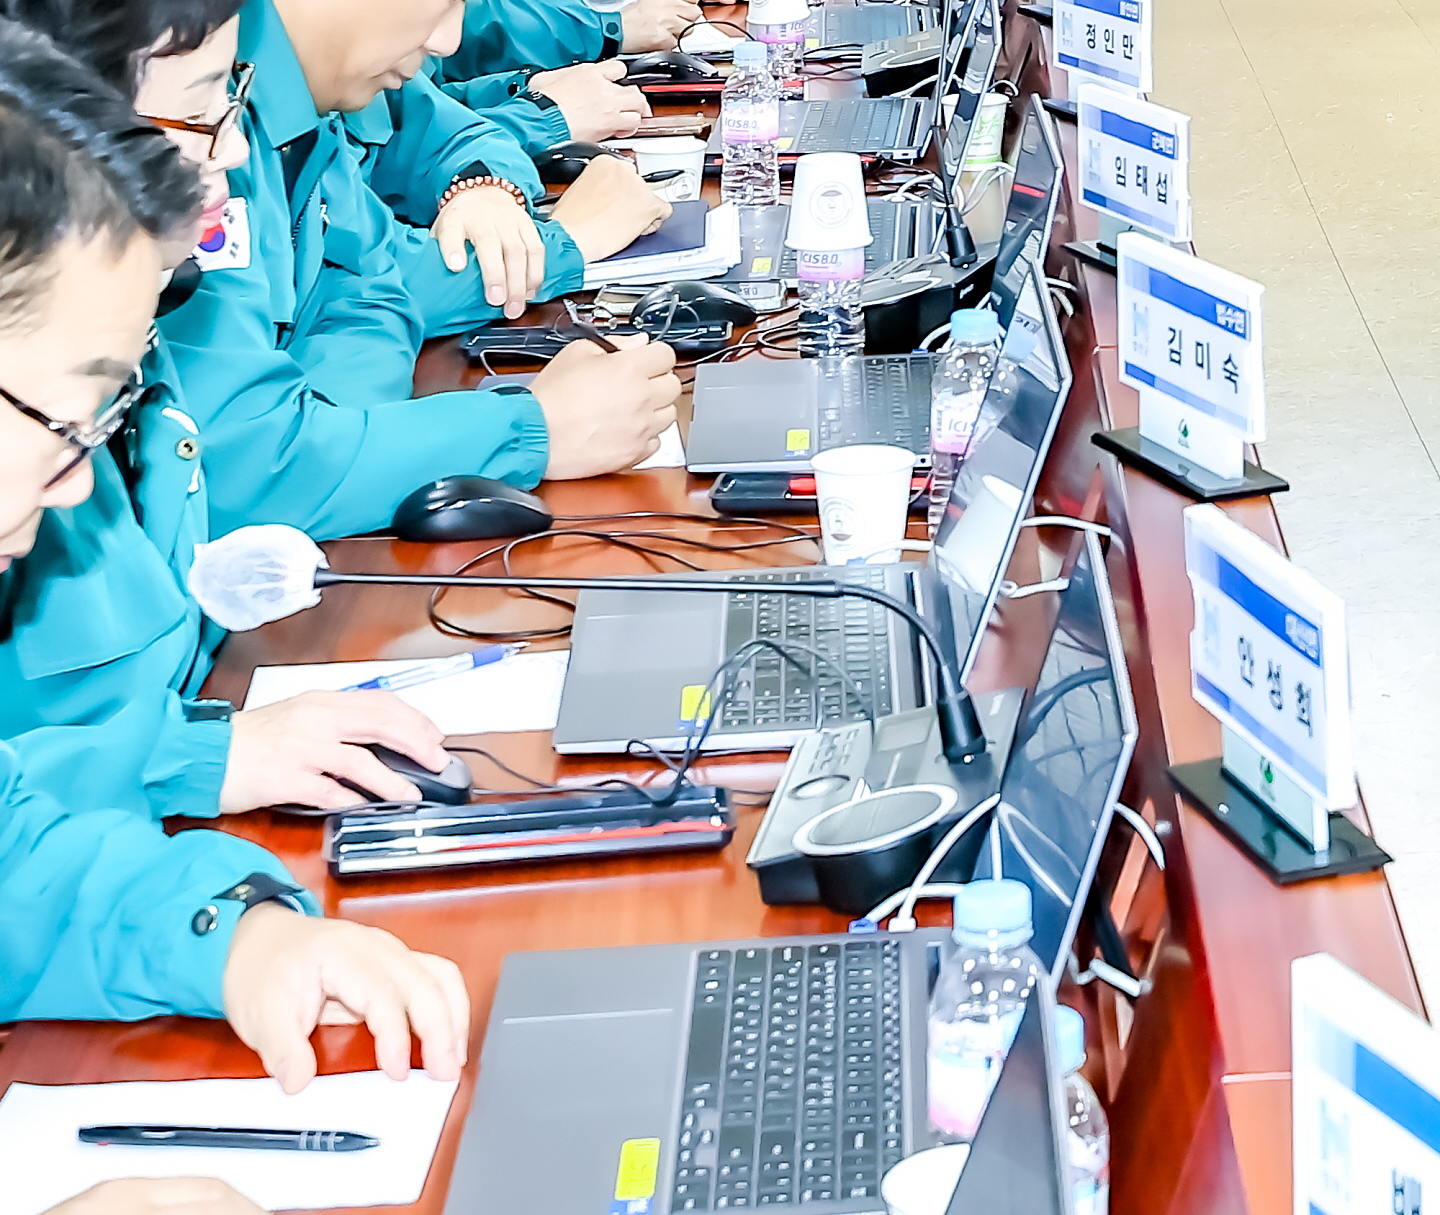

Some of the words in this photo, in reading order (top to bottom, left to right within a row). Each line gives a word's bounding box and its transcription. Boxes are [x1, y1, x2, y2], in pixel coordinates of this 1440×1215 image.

[1085, 23, 1134, 61] 정인만
[1114, 154, 1169, 206] 임태섭
[1167, 325, 1240, 395] 김미숙
